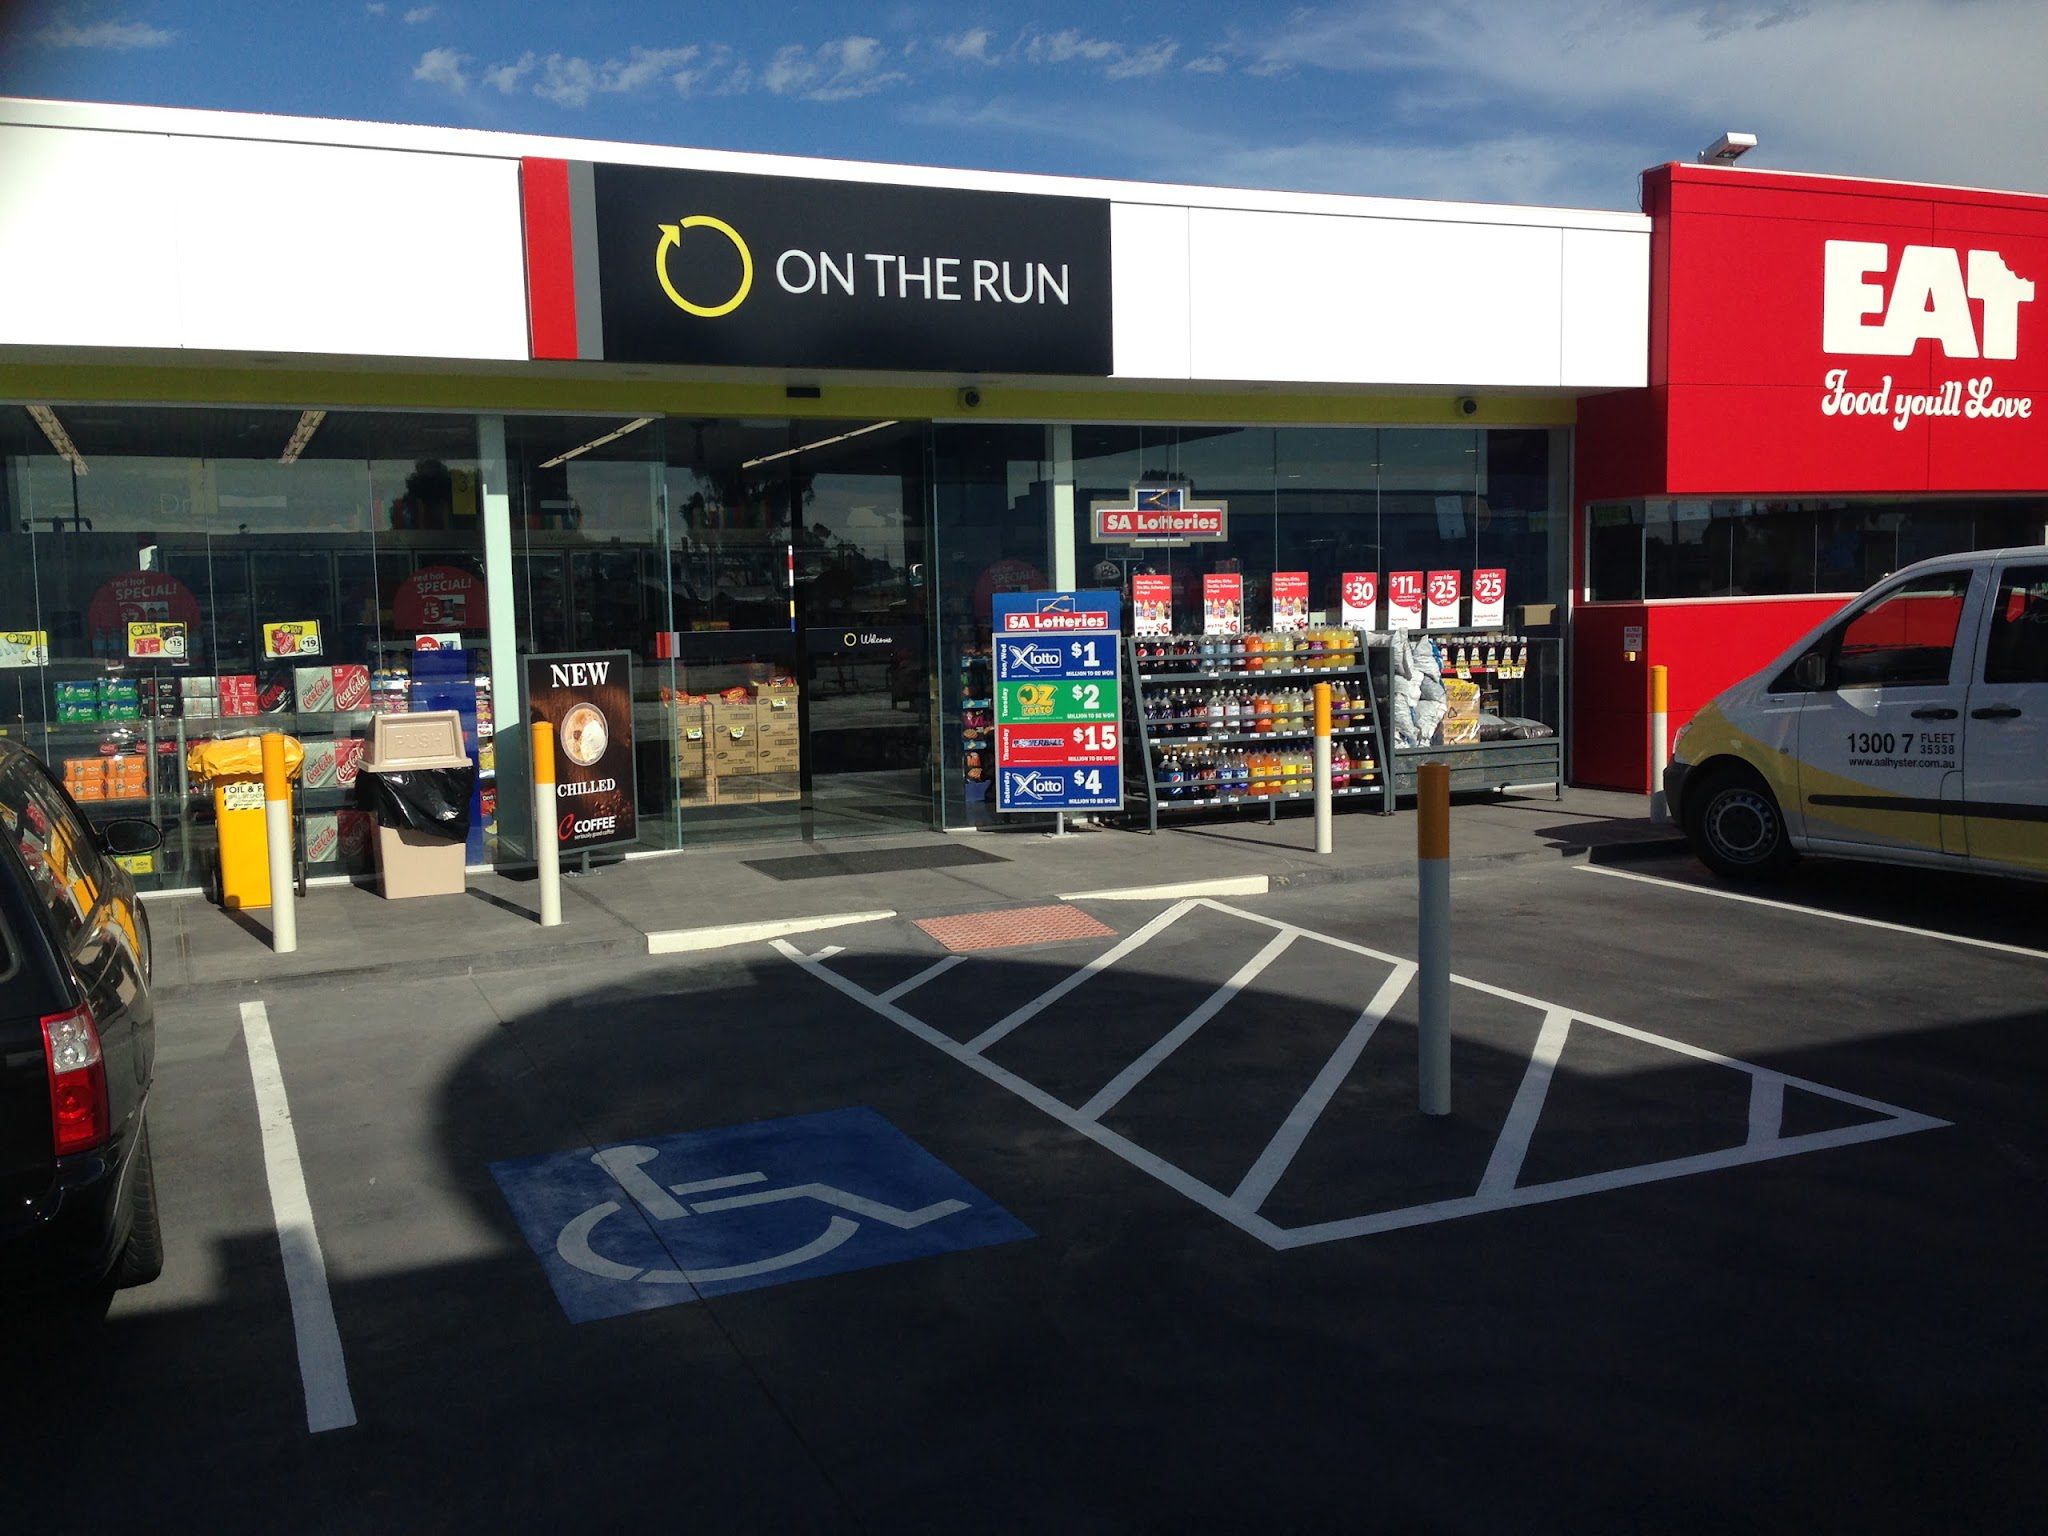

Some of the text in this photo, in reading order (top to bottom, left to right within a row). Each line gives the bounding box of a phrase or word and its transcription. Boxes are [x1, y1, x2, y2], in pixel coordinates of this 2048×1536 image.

[775, 249, 1069, 305] ON THE RUN
[1822, 239, 2036, 361] EAT
[1821, 368, 2032, 431] Food you'll Love
[1107, 513, 1218, 530] SA Lotteries
[115, 583, 177, 601] SPECIAL!
[417, 578, 472, 594] SPECIAL!
[1345, 582, 1374, 601] $30
[1430, 580, 1457, 599] $25
[1476, 578, 1502, 597] $25
[1008, 613, 1105, 629] SA Lotteries
[1156, 622, 1169, 634] $6
[1225, 620, 1238, 632] $6
[169, 640, 182, 648] $15
[302, 639, 316, 648] $19
[1000, 643, 1008, 679] Mon/Wed
[1071, 641, 1100, 667] $1
[550, 661, 610, 688] NEW
[1001, 687, 1009, 718] Tuesday
[1017, 683, 1058, 706] OZ
[1071, 684, 1100, 709] $2
[395, 733, 443, 749] PUSH
[1002, 728, 1010, 761] Thursday
[1072, 725, 1117, 751] $15
[1847, 733, 1914, 754] 1300 7
[1920, 733, 1955, 744] FLEET
[1920, 744, 1955, 755] 35338
[229, 786, 245, 794] OIL
[556, 778, 616, 798] CHILLED
[1003, 771, 1011, 804] Saturday
[1073, 769, 1103, 795] $4
[574, 815, 616, 834] COFFEE
